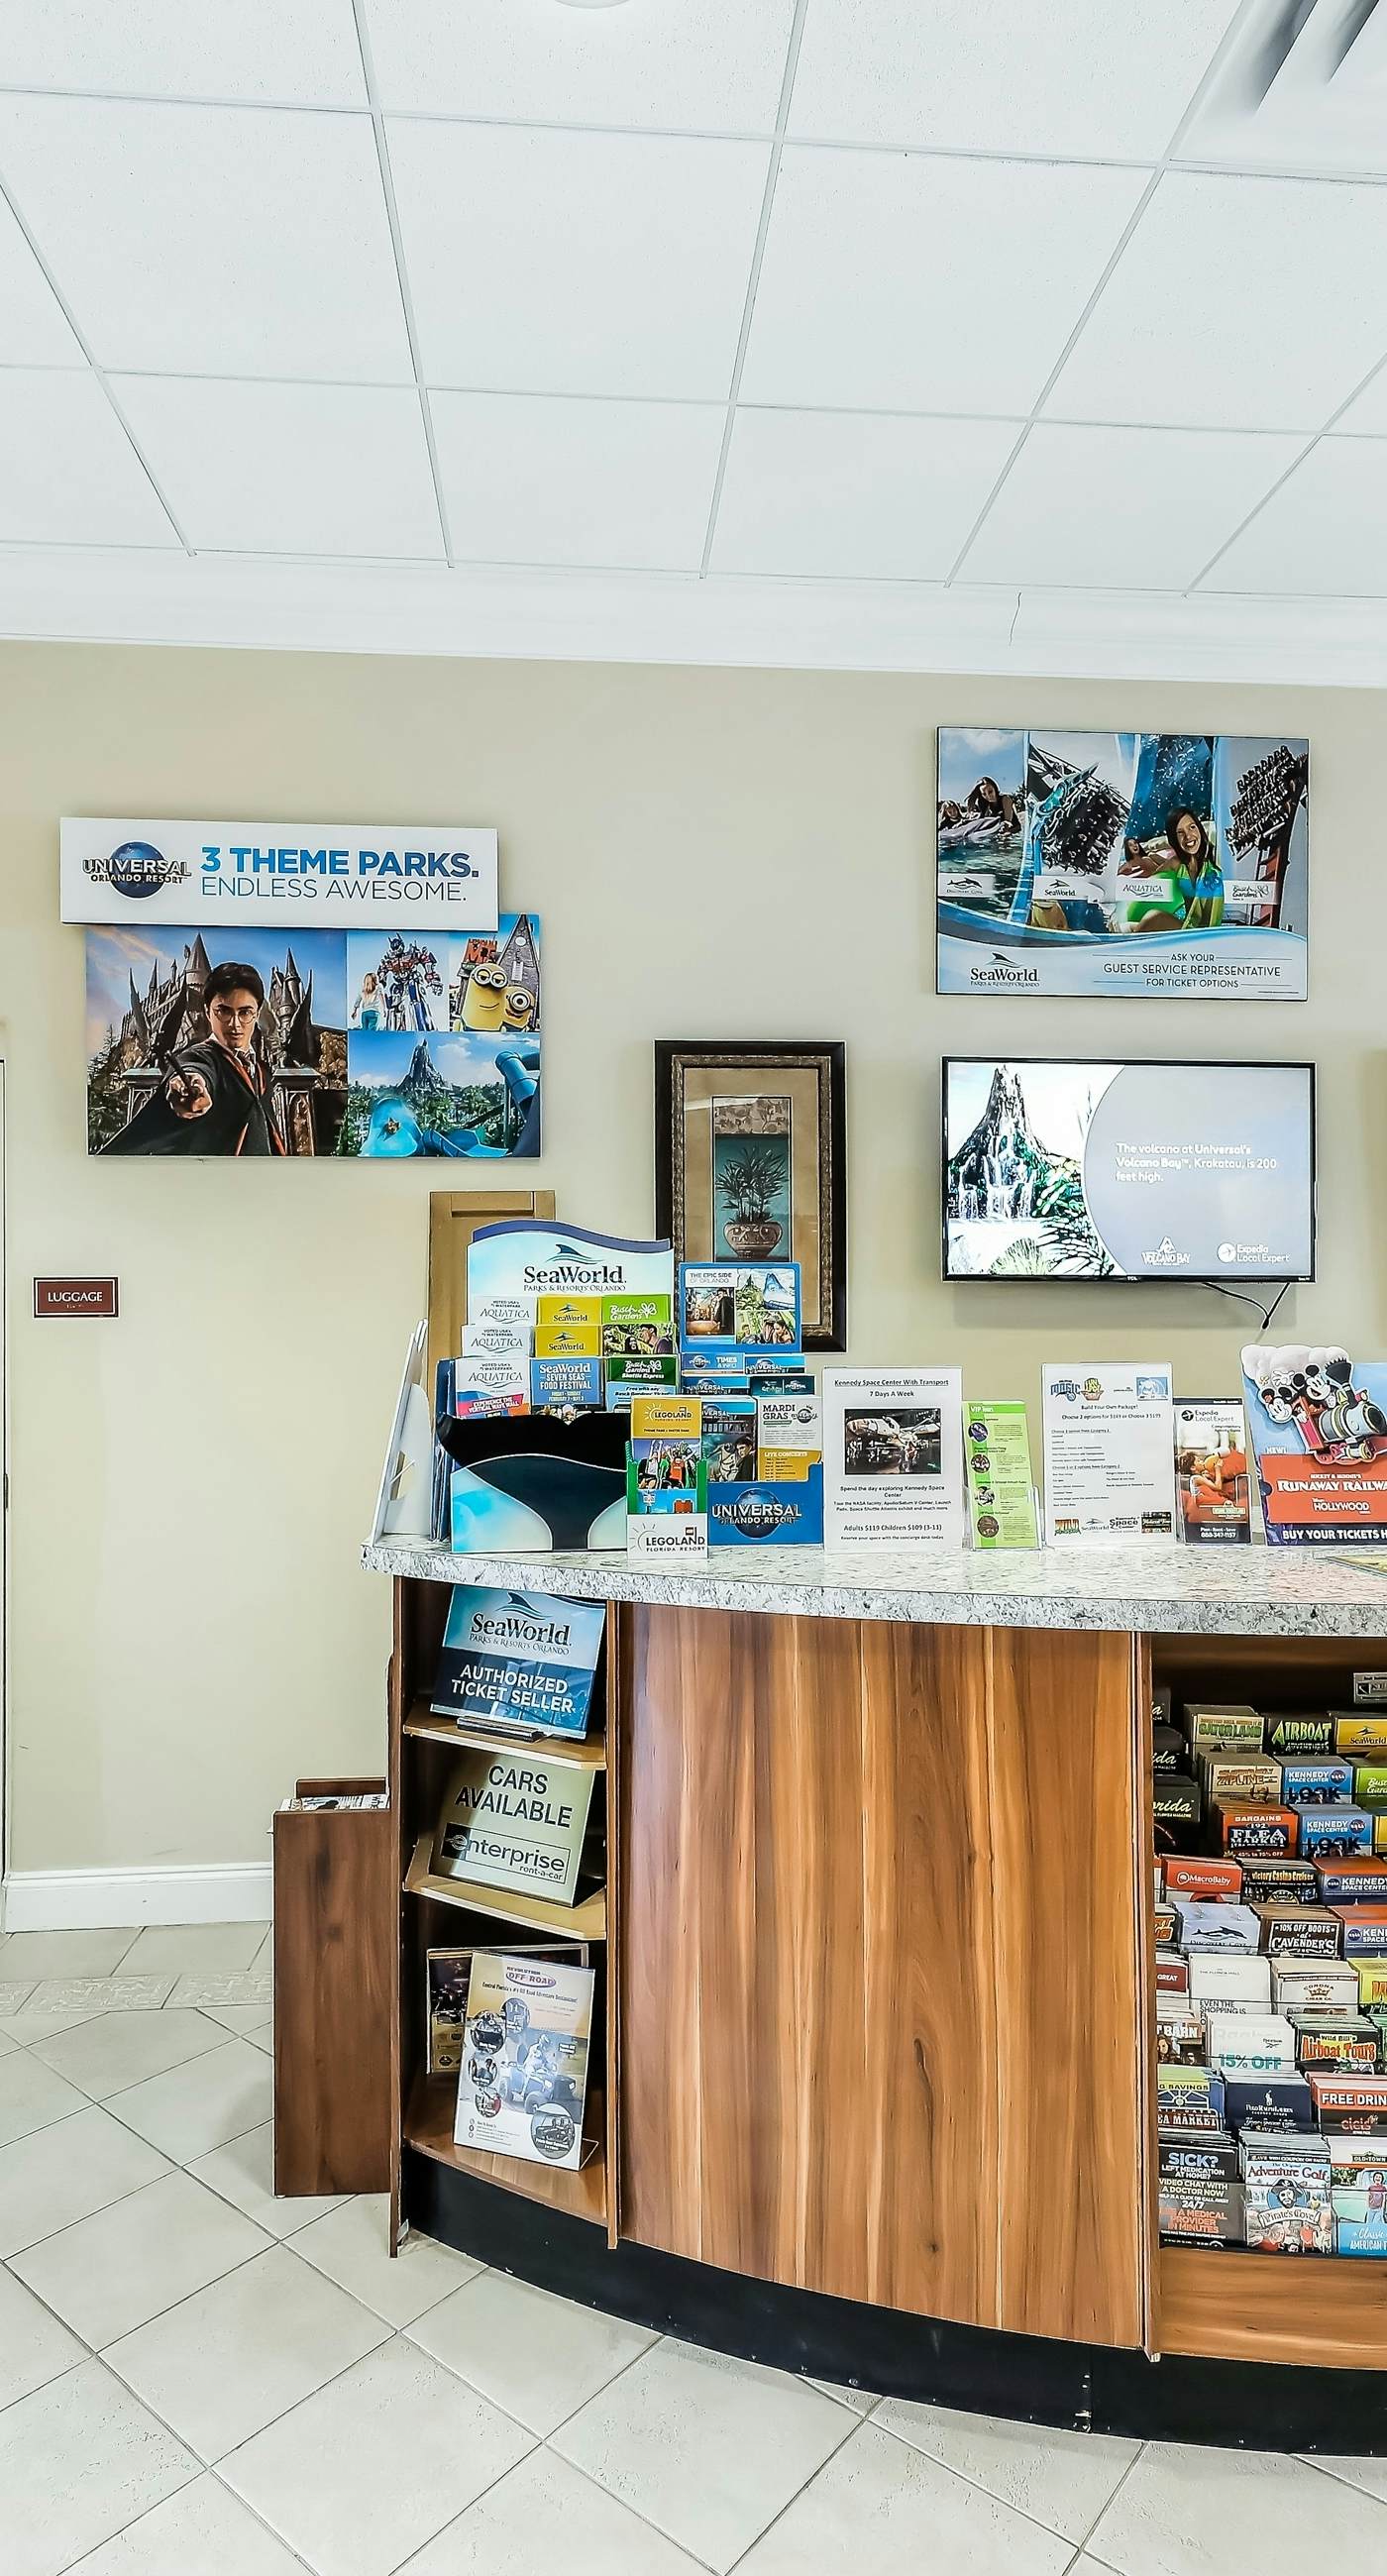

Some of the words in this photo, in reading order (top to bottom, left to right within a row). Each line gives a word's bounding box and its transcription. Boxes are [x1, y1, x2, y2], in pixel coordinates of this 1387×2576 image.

[82, 859, 191, 876] UNIVERSAL
[200, 847, 221, 873] 3
[230, 847, 349, 875] THEME
[359, 851, 479, 878] PARKS.
[90, 874, 142, 883] ORLANDO
[146, 875, 184, 885] RESORT
[202, 876, 317, 898] ENDLESS
[325, 879, 467, 901] AWESOME.
[1122, 884, 1163, 893] AQUATICA
[970, 968, 1038, 982] SeaWorld
[1104, 963, 1139, 974] GUEST
[1141, 964, 1188, 975] SERVICE
[1190, 965, 1281, 977] REPRESENTATIVE
[1146, 978, 1164, 987] FOR
[1166, 979, 1197, 988] TICKET
[1199, 979, 1238, 988] OPTIONS
[1117, 1142, 1137, 1154] The
[1139, 1143, 1179, 1154] volcano
[1181, 1144, 1193, 1154] at
[1194, 1143, 1251, 1154] Universal's
[1116, 1156, 1159, 1168] Volcano
[1194, 1157, 1245, 1170] Krakatau,
[1246, 1157, 1255, 1169] is
[1257, 1158, 1277, 1169] 200
[1116, 1171, 1137, 1182] feet
[1138, 1171, 1164, 1184] high.
[1237, 1243, 1268, 1253] Expedia
[1141, 1251, 1176, 1264] VOLCANO
[1177, 1252, 1191, 1264] BAY
[1237, 1253, 1260, 1262] Local
[1261, 1253, 1290, 1264] Expert
[48, 1292, 103, 1302] LUGGAGE
[480, 1308, 530, 1319] AQUATICA
[553, 1314, 587, 1323] SeaWorld
[610, 1312, 642, 1321] Gardens
[471, 1337, 523, 1348] AQUATICA
[539, 1363, 591, 1373] SeaWorld
[469, 1371, 523, 1382] AQUATICA
[540, 1381, 558, 1390] FOOD
[560, 1381, 591, 1390] FESTIVAL
[1277, 1480, 1342, 1491] RUNAWAY
[711, 1503, 802, 1517] UNIVERSAL
[1314, 1501, 1369, 1511] HOLLYWOOD
[1283, 1530, 1304, 1539] BUY
[1306, 1530, 1335, 1540] YOUR
[1336, 1529, 1379, 1540] TICKETS
[470, 1634, 491, 1644] PARKS
[500, 1638, 531, 1651] RESORTS
[533, 1643, 570, 1656] ORLANDO
[460, 1664, 568, 1694] AUTHORIZED
[451, 1679, 508, 1701] TICKET
[511, 1690, 574, 1713] SELLER
[1271, 1720, 1332, 1745] AIRBOAT
[1350, 1735, 1387, 1744] SeaWorld
[488, 1766, 548, 1794] CARS
[1218, 1774, 1265, 1786] ZIPLINE
[1289, 1771, 1330, 1779] KENNEDY
[455, 1786, 573, 1828] AVAILABLE
[1230, 1828, 1285, 1841] FLEA
[1230, 1838, 1285, 1848] MARKET
[451, 1834, 565, 1872] enterprise
[519, 1866, 563, 1880] rent-a-car
[1272, 1870, 1292, 1881] Casino
[1292, 1871, 1315, 1881] Cruises
[1189, 1874, 1231, 1886] MacroBaby
[1341, 1877, 1387, 1885] KENNEDY
[1272, 1937, 1335, 1952] CAVENDER'S
[508, 1973, 527, 1982] OFF
[529, 1975, 555, 1985] ROAD
[1163, 2025, 1198, 2038] BARN
[1301, 2035, 1340, 2061] Airboat
[1343, 2042, 1377, 2063] Tours
[1219, 2053, 1248, 2069] 15%
[1251, 2055, 1282, 2070] OFF
[1322, 2093, 1354, 2105] FREE
[1172, 2114, 1218, 2126] MARKET
[1168, 2152, 1219, 2168] SICK?
[1180, 2166, 1226, 2177] MEDICATION
[1247, 2165, 1299, 2178] Adventure
[1302, 2167, 1327, 2180] Golf
[1169, 2187, 1203, 2196] DOCTOR
[1182, 2200, 1205, 2209] 24/7
[1188, 2209, 1227, 2219] MEDICAL
[1264, 2209, 1294, 2222] Pirate's
[1294, 2209, 1316, 2220] Cove
[1172, 2215, 1216, 2226] PROVIDER
[1179, 2223, 1220, 2233] MINUTES
[1349, 2241, 1383, 2250] AMERICAN
